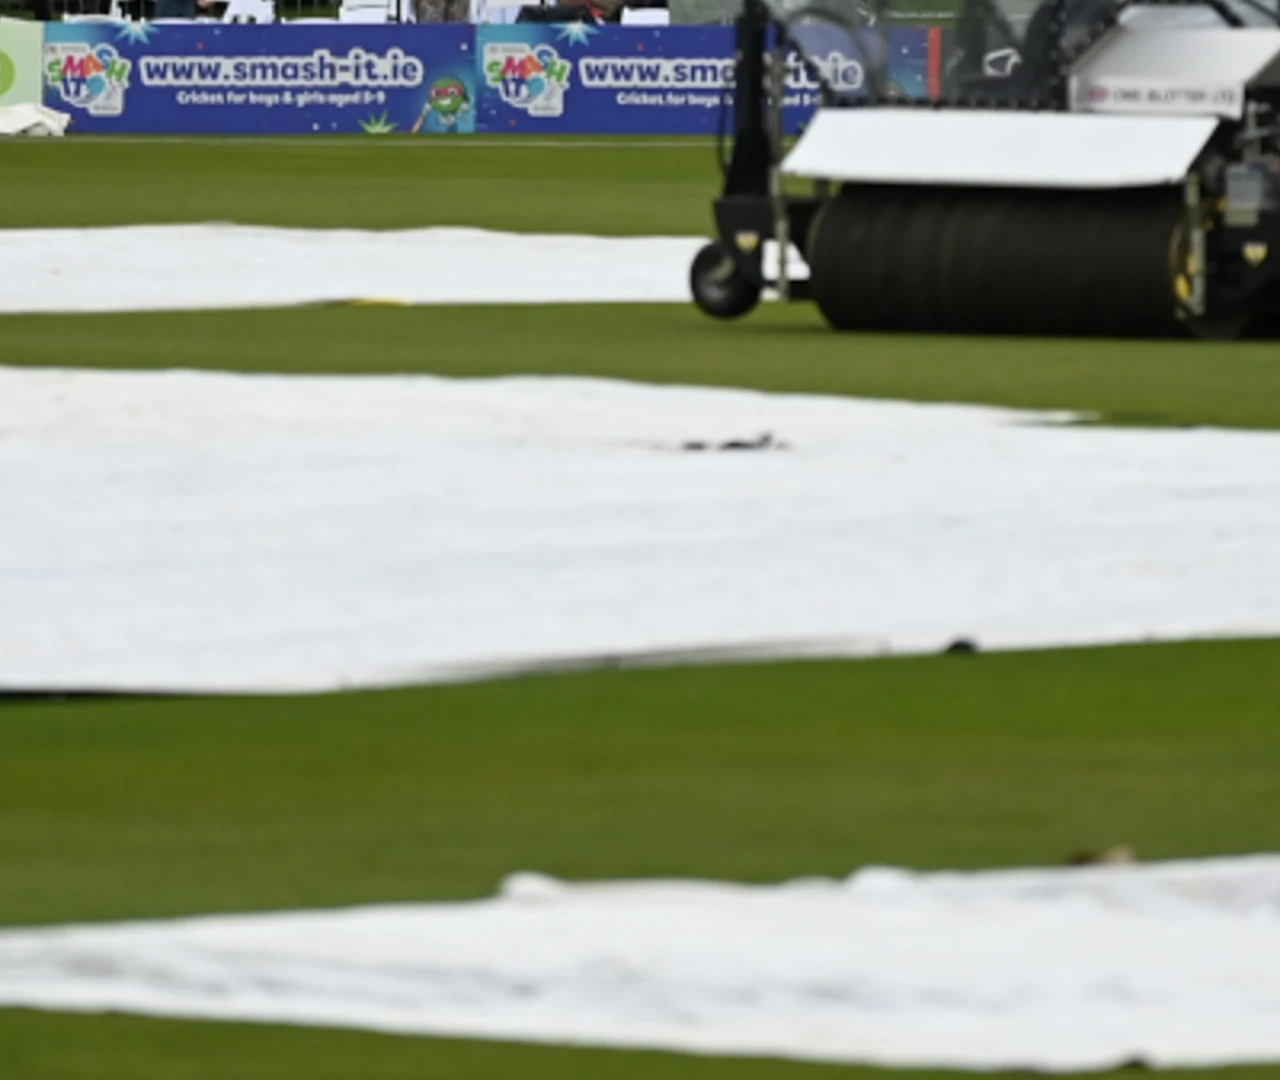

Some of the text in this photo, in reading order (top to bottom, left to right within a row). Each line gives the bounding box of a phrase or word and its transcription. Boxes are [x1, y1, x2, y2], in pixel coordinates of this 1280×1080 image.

[47, 49, 130, 83] SMASH
[143, 51, 420, 81] www.smash-it.ie
[487, 49, 568, 83] SMASH
[249, 91, 279, 109] boys
